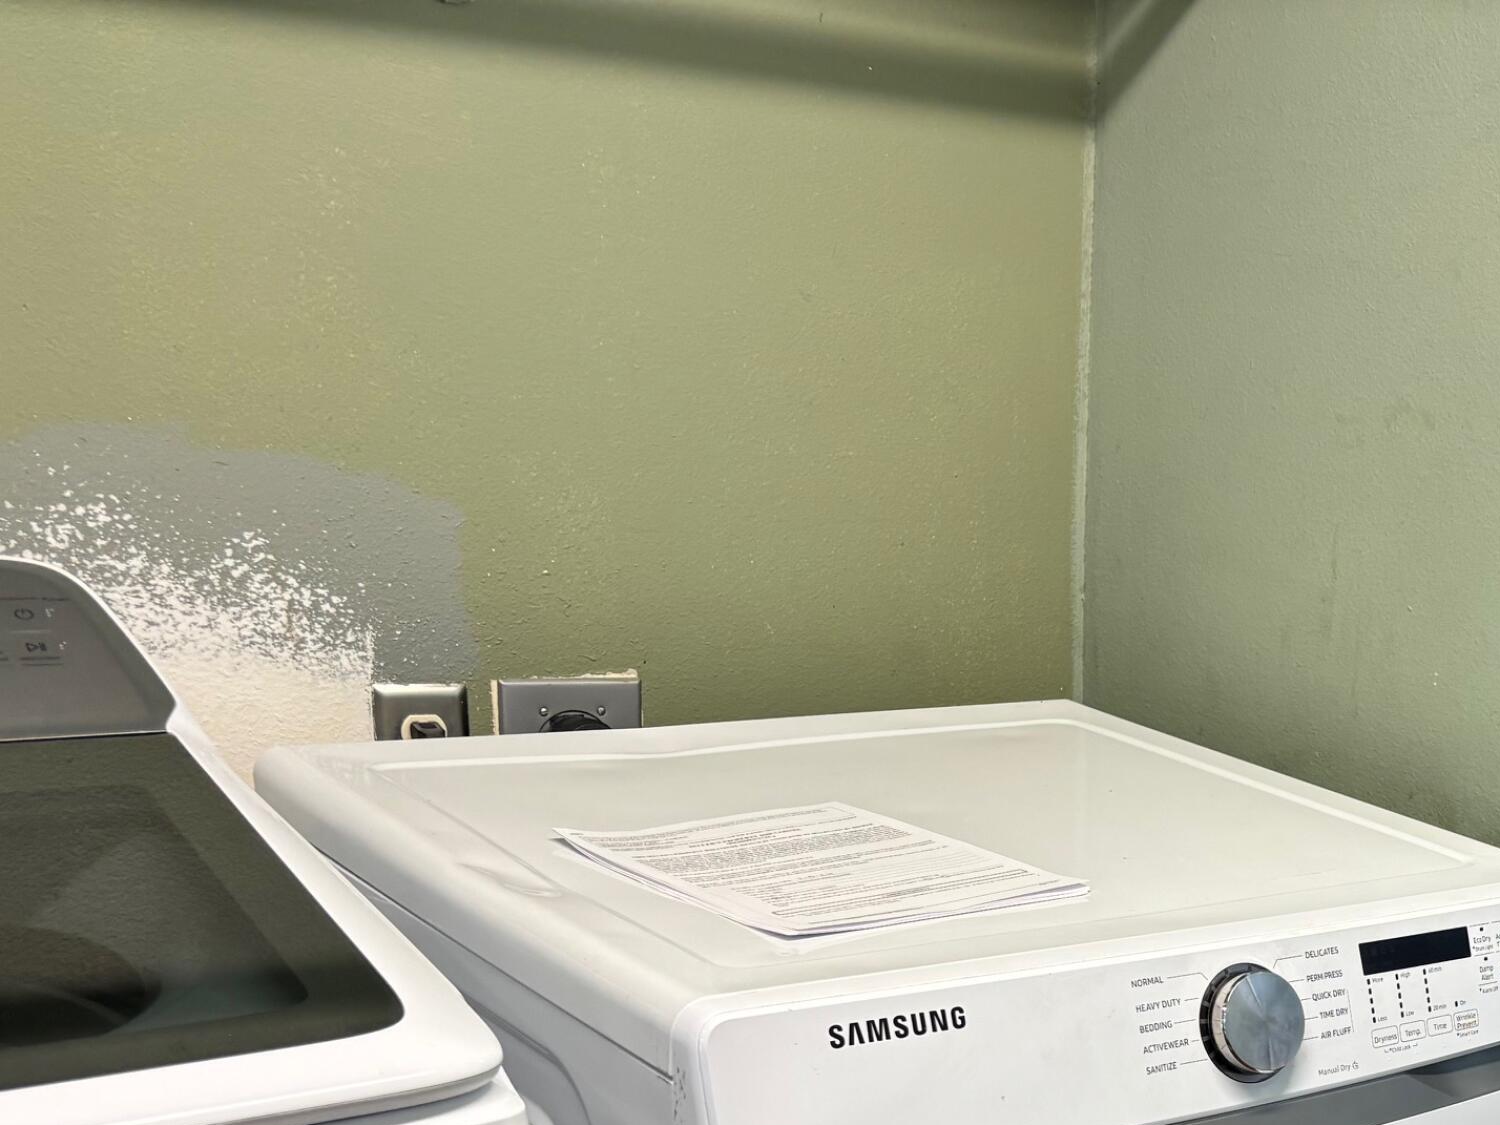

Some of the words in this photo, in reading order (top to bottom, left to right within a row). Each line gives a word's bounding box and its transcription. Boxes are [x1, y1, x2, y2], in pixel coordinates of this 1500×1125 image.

[1304, 945, 1339, 959] DELICATES
[1306, 973, 1323, 982] PERM
[1324, 969, 1343, 980] PRESS
[1130, 976, 1164, 989] NORMAL
[1311, 991, 1332, 1001] QUICK
[1332, 988, 1346, 998] DRY
[1136, 1000, 1161, 1013] HEAVY
[1161, 998, 1181, 1009] DUTY
[1319, 1009, 1335, 1019] TIME
[1335, 1007, 1349, 1016] DRY
[828, 1006, 967, 1049] SAMSUNG
[1139, 1020, 1173, 1034] BEDDING
[1320, 1030, 1332, 1040] AIR
[1332, 1026, 1352, 1037] FLUFF
[1374, 1034, 1398, 1044] Dryness
[1143, 1038, 1190, 1054] ACTIVEWEAR
[1145, 1062, 1178, 1075] SANITIZE
[1318, 1065, 1339, 1076] Manual
[1340, 1063, 1351, 1073] Dry
